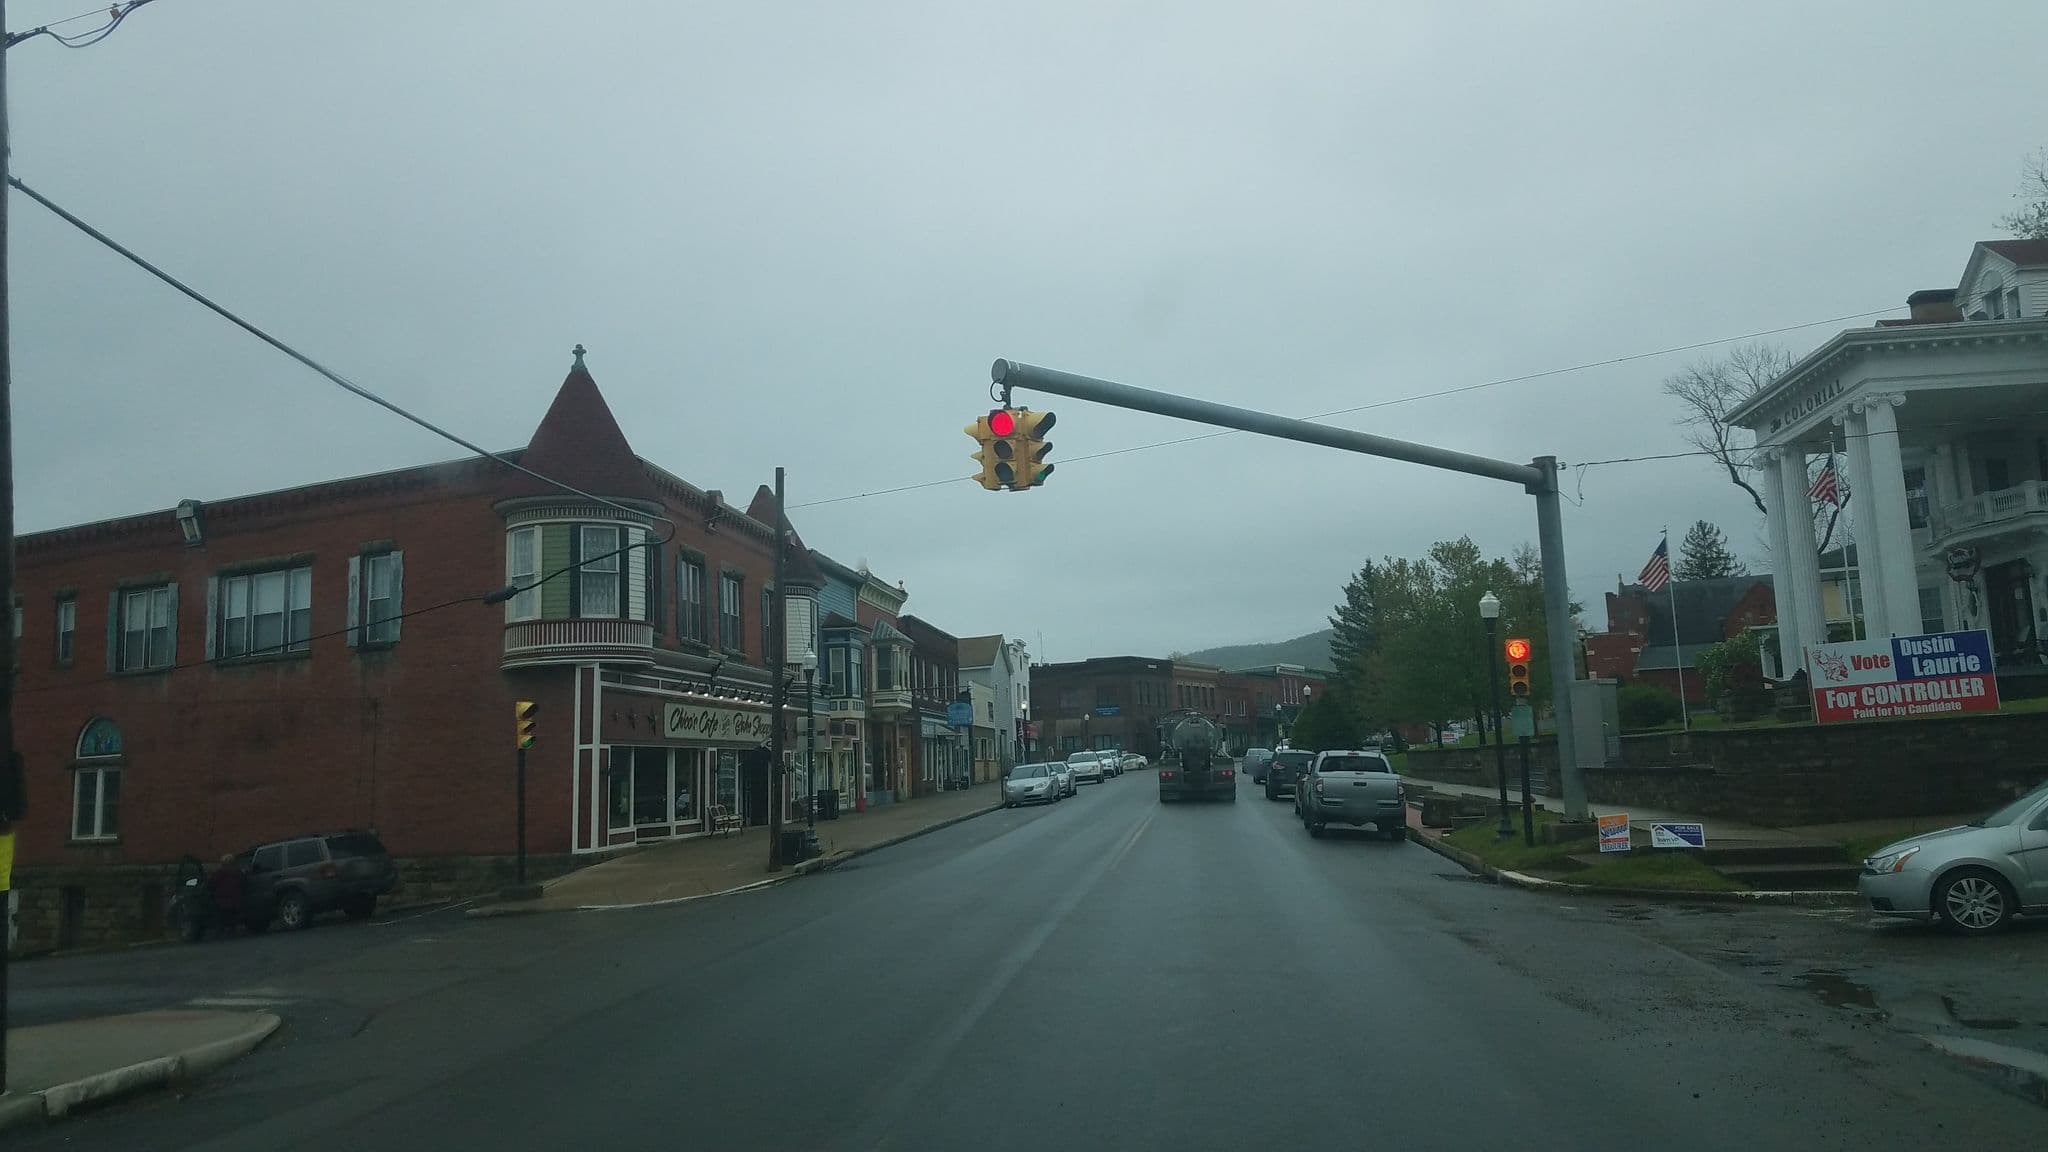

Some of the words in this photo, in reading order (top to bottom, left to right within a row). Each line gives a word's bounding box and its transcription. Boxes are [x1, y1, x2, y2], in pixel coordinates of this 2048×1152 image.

[1784, 379, 1845, 425] COLONIAL
[1900, 636, 1956, 657] Dustin
[1850, 653, 1892, 671] Vote
[1911, 652, 1981, 678] Laurie
[1825, 689, 1858, 709] For
[1861, 677, 1986, 706] CONTROLLER
[1853, 708, 1876, 720] Paid
[1877, 706, 1893, 718] for
[1894, 704, 1907, 717] by
[1908, 700, 1962, 715] Candidate
